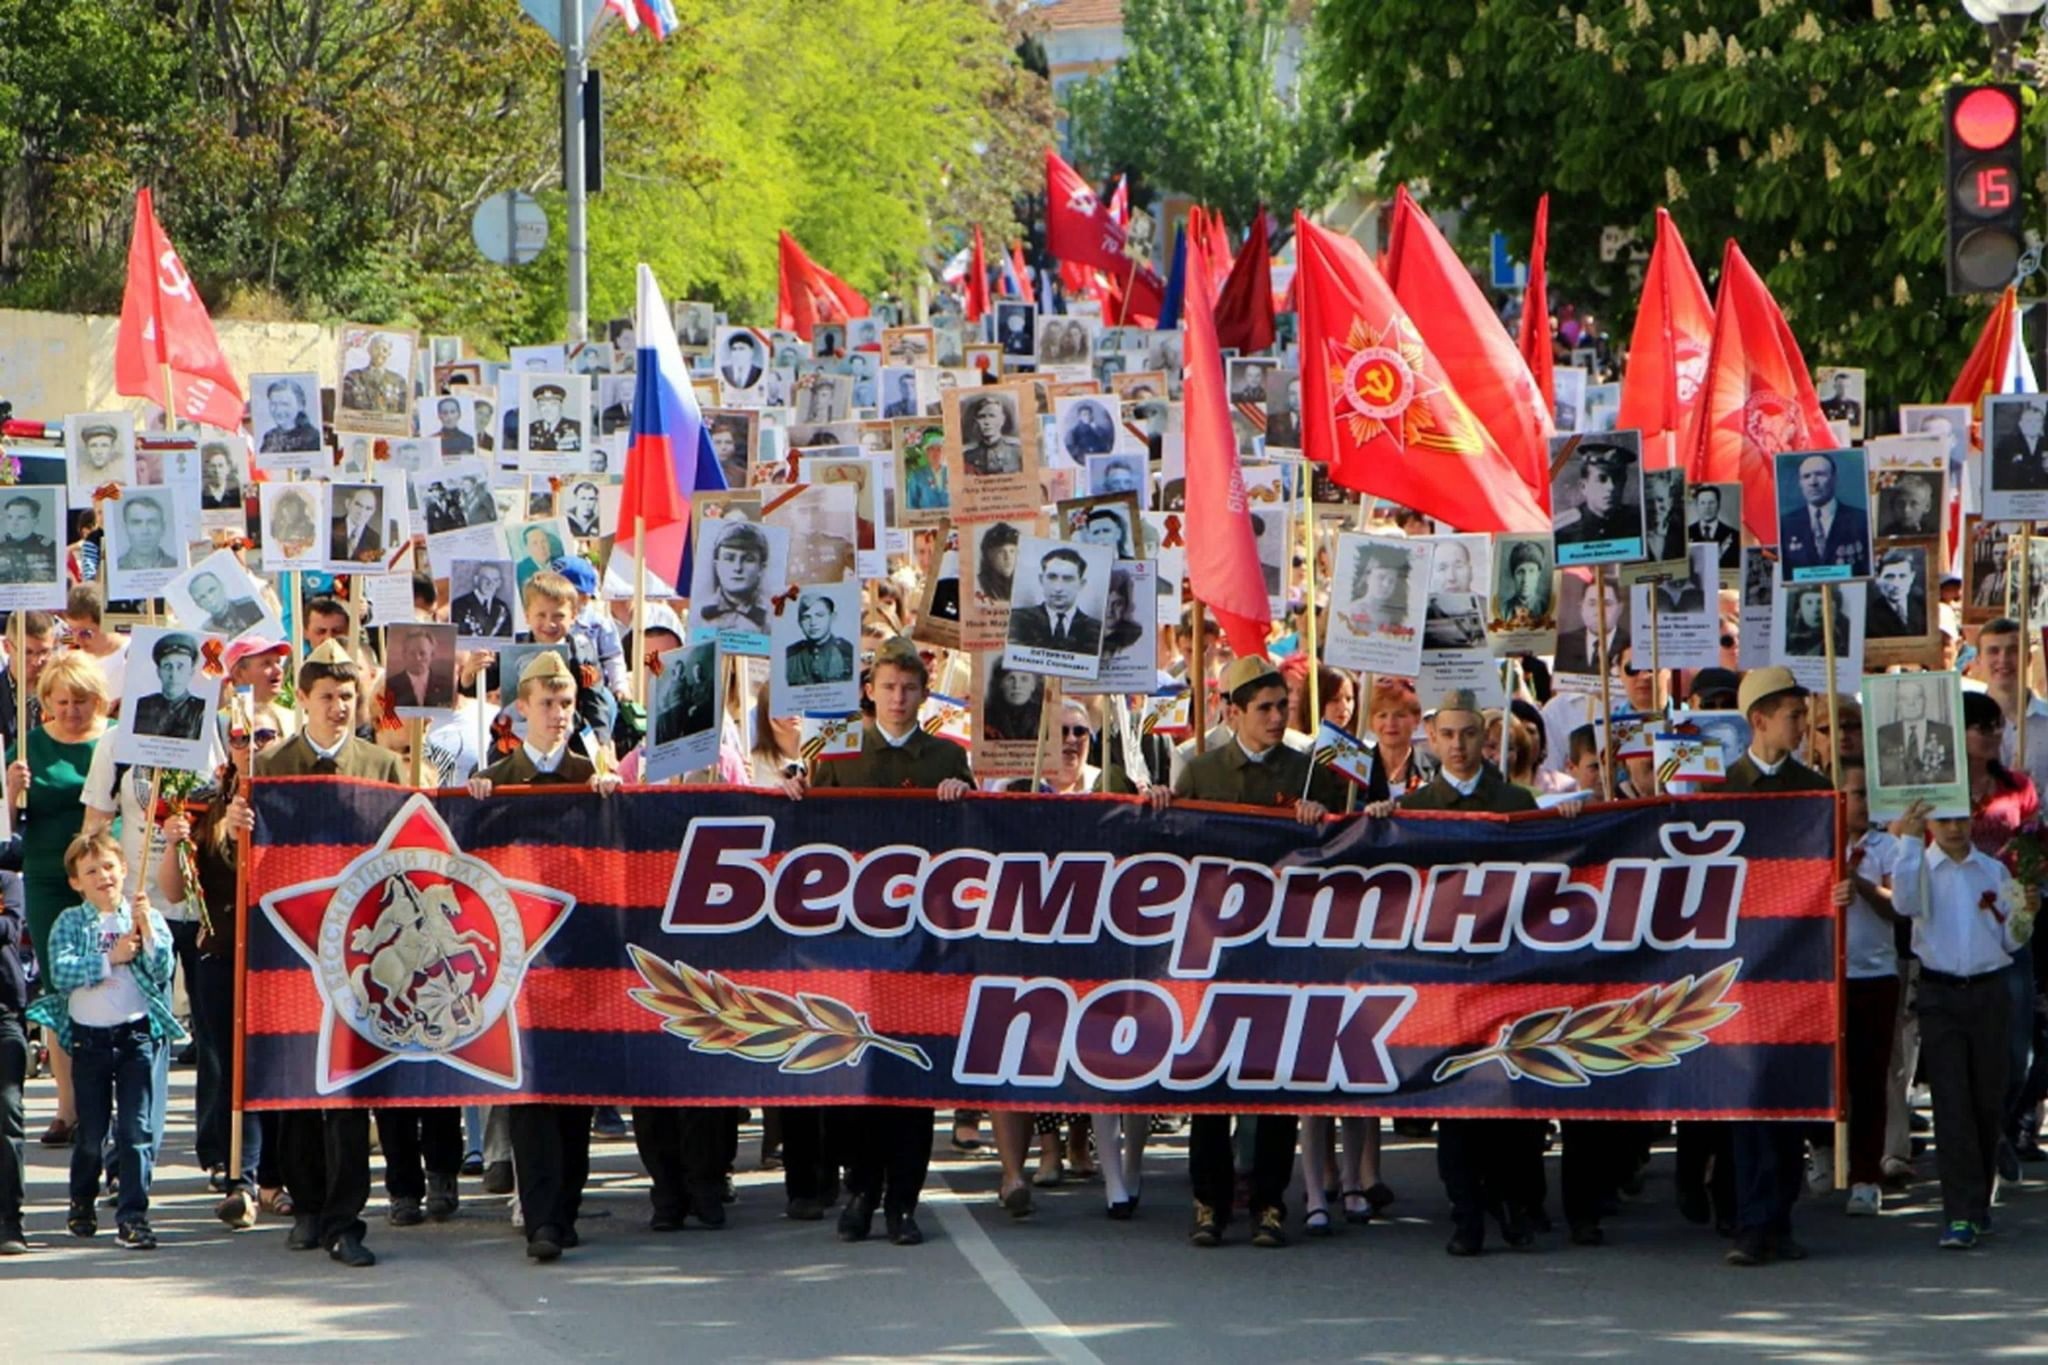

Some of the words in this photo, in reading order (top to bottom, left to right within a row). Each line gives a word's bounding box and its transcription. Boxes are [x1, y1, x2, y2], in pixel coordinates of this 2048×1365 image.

[1976, 167, 2012, 209] 15
[324, 850, 420, 990] БЕССМЕРТНЫЙ
[427, 854, 490, 893] ПОЛК
[491, 886, 522, 987] РОССИИ
[661, 816, 1748, 979] Бессмертный
[952, 976, 1418, 1094] полк
